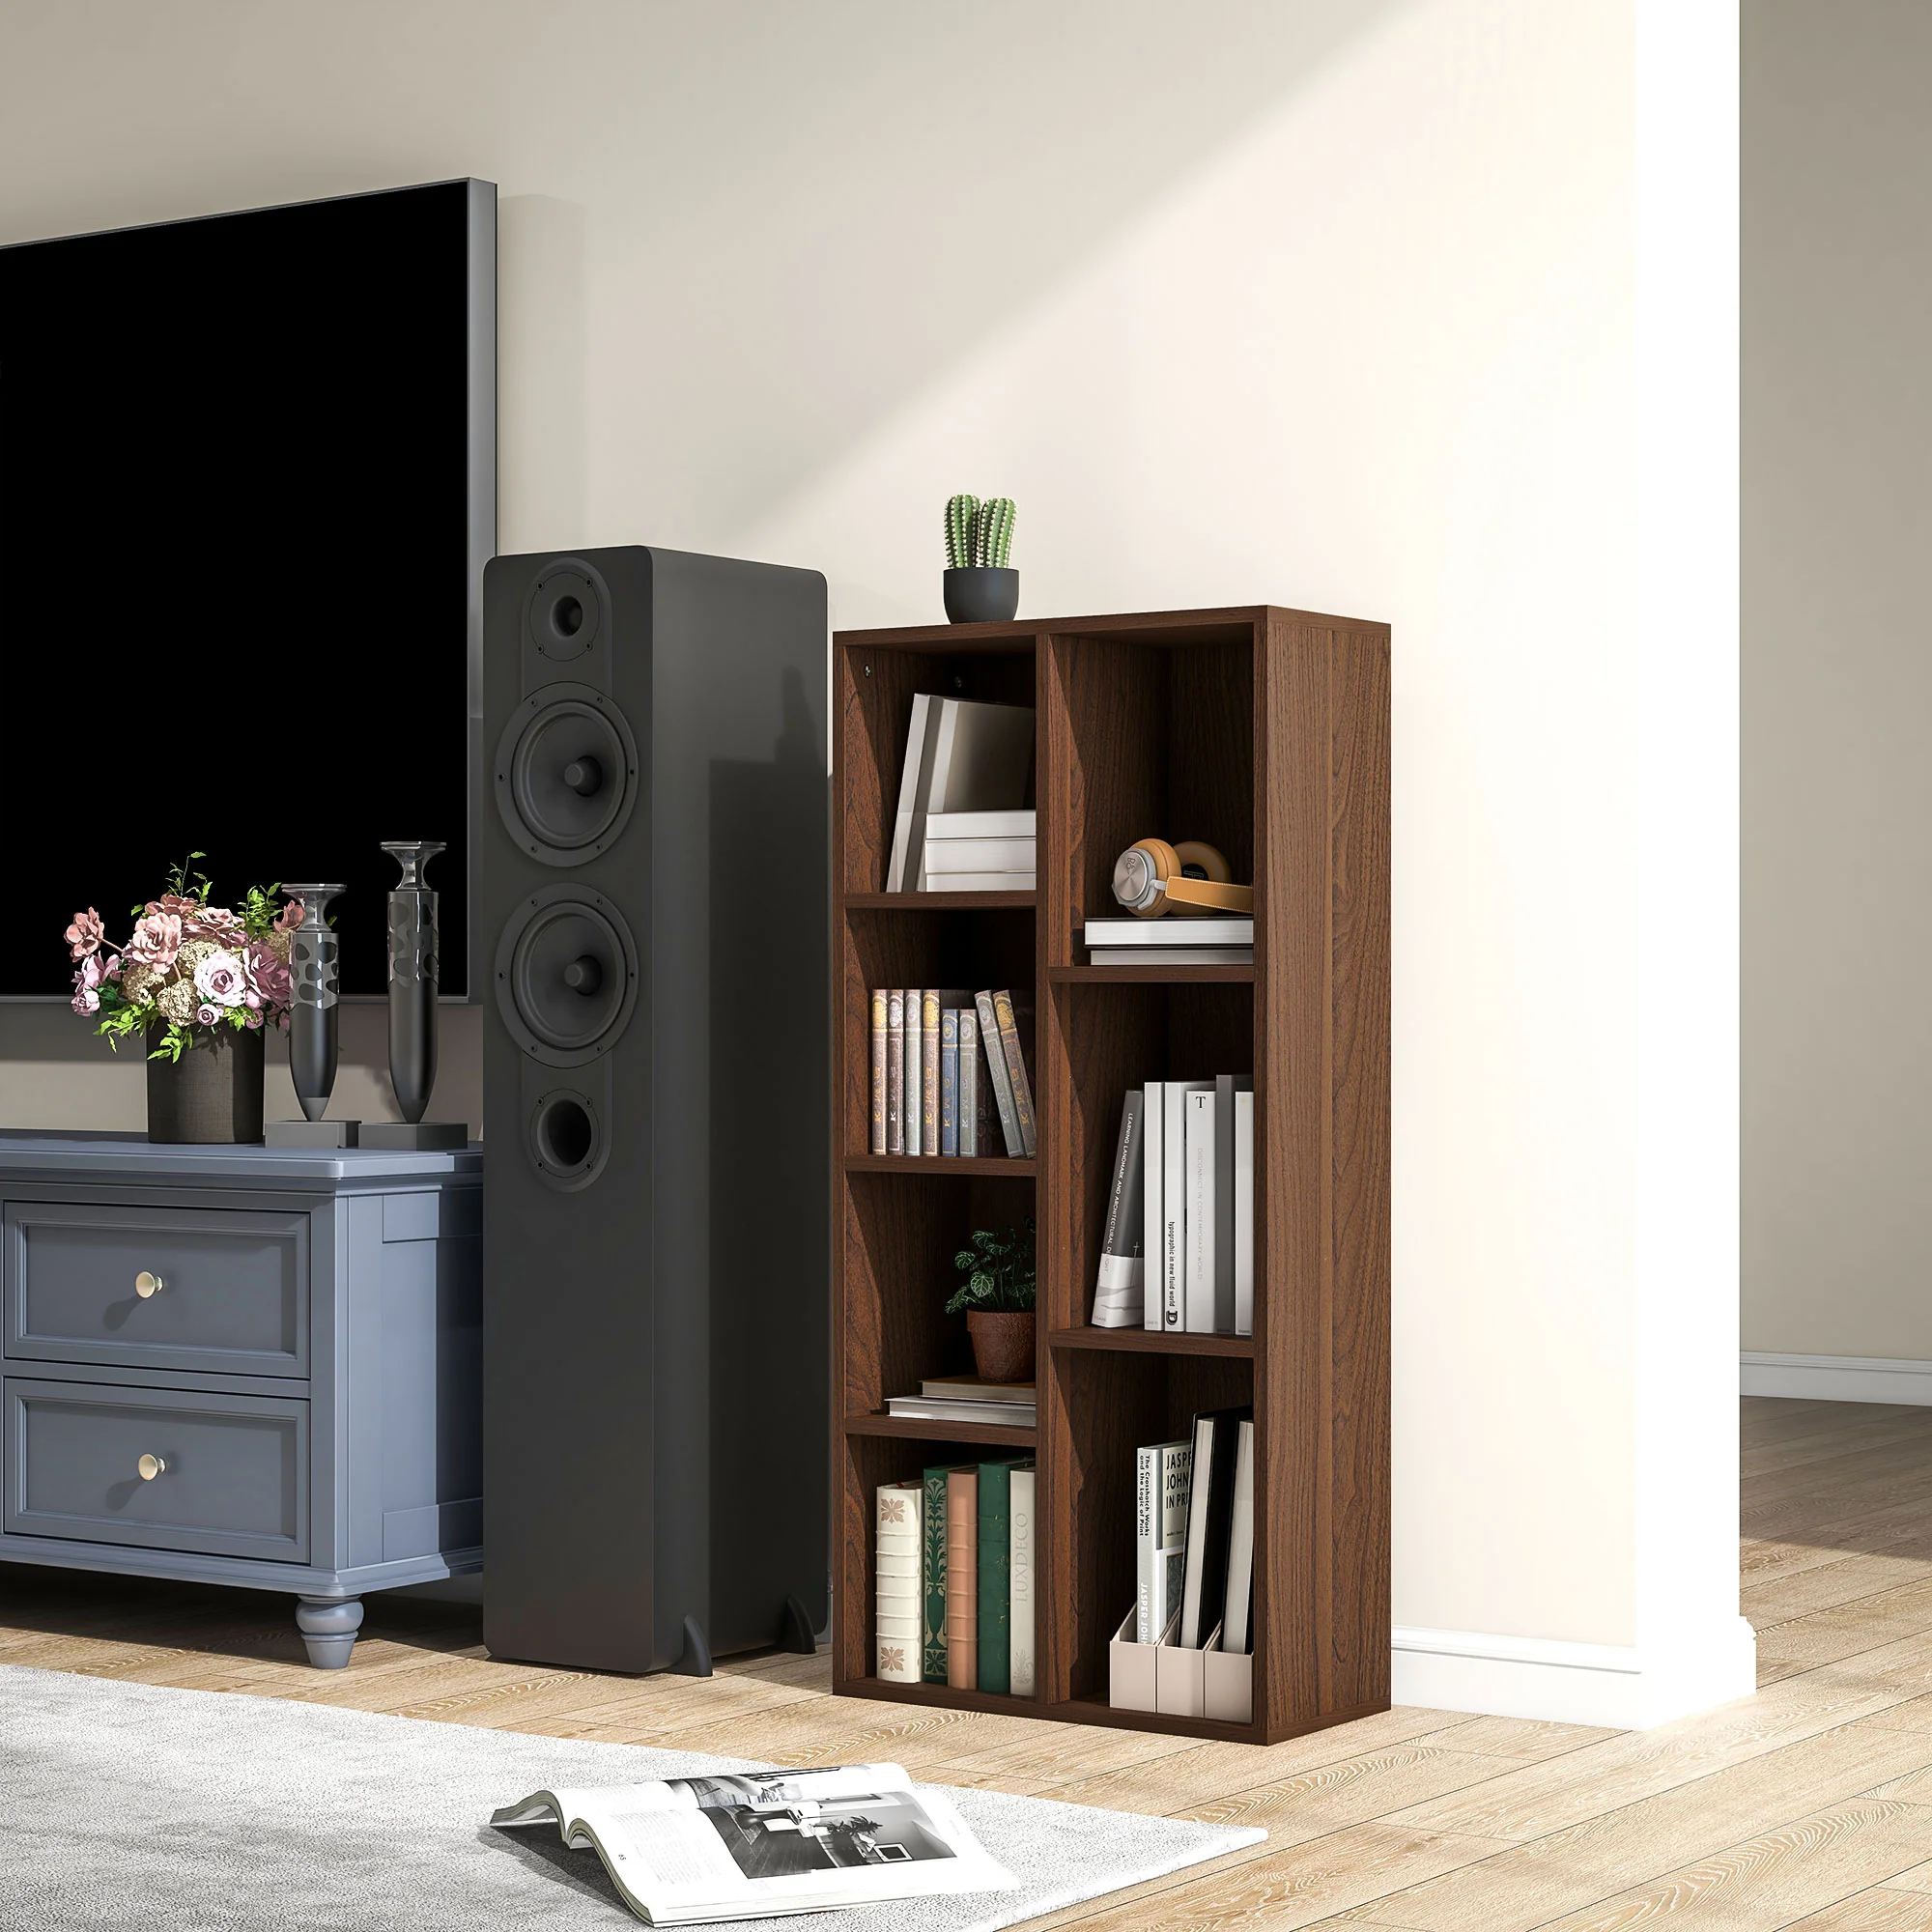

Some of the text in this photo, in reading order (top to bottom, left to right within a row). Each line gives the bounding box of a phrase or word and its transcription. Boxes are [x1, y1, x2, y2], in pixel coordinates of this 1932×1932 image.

[1196, 1096, 1206, 1108] T
[1124, 1113, 1133, 1143] LEARNING
[1119, 1146, 1128, 1179] LANDMARK
[1108, 1196, 1120, 1244] ARCHITECTURAL
[1140, 1509, 1145, 1518] of
[1166, 1494, 1175, 1509] IN
[1015, 1513, 1028, 1603] LUXDECO
